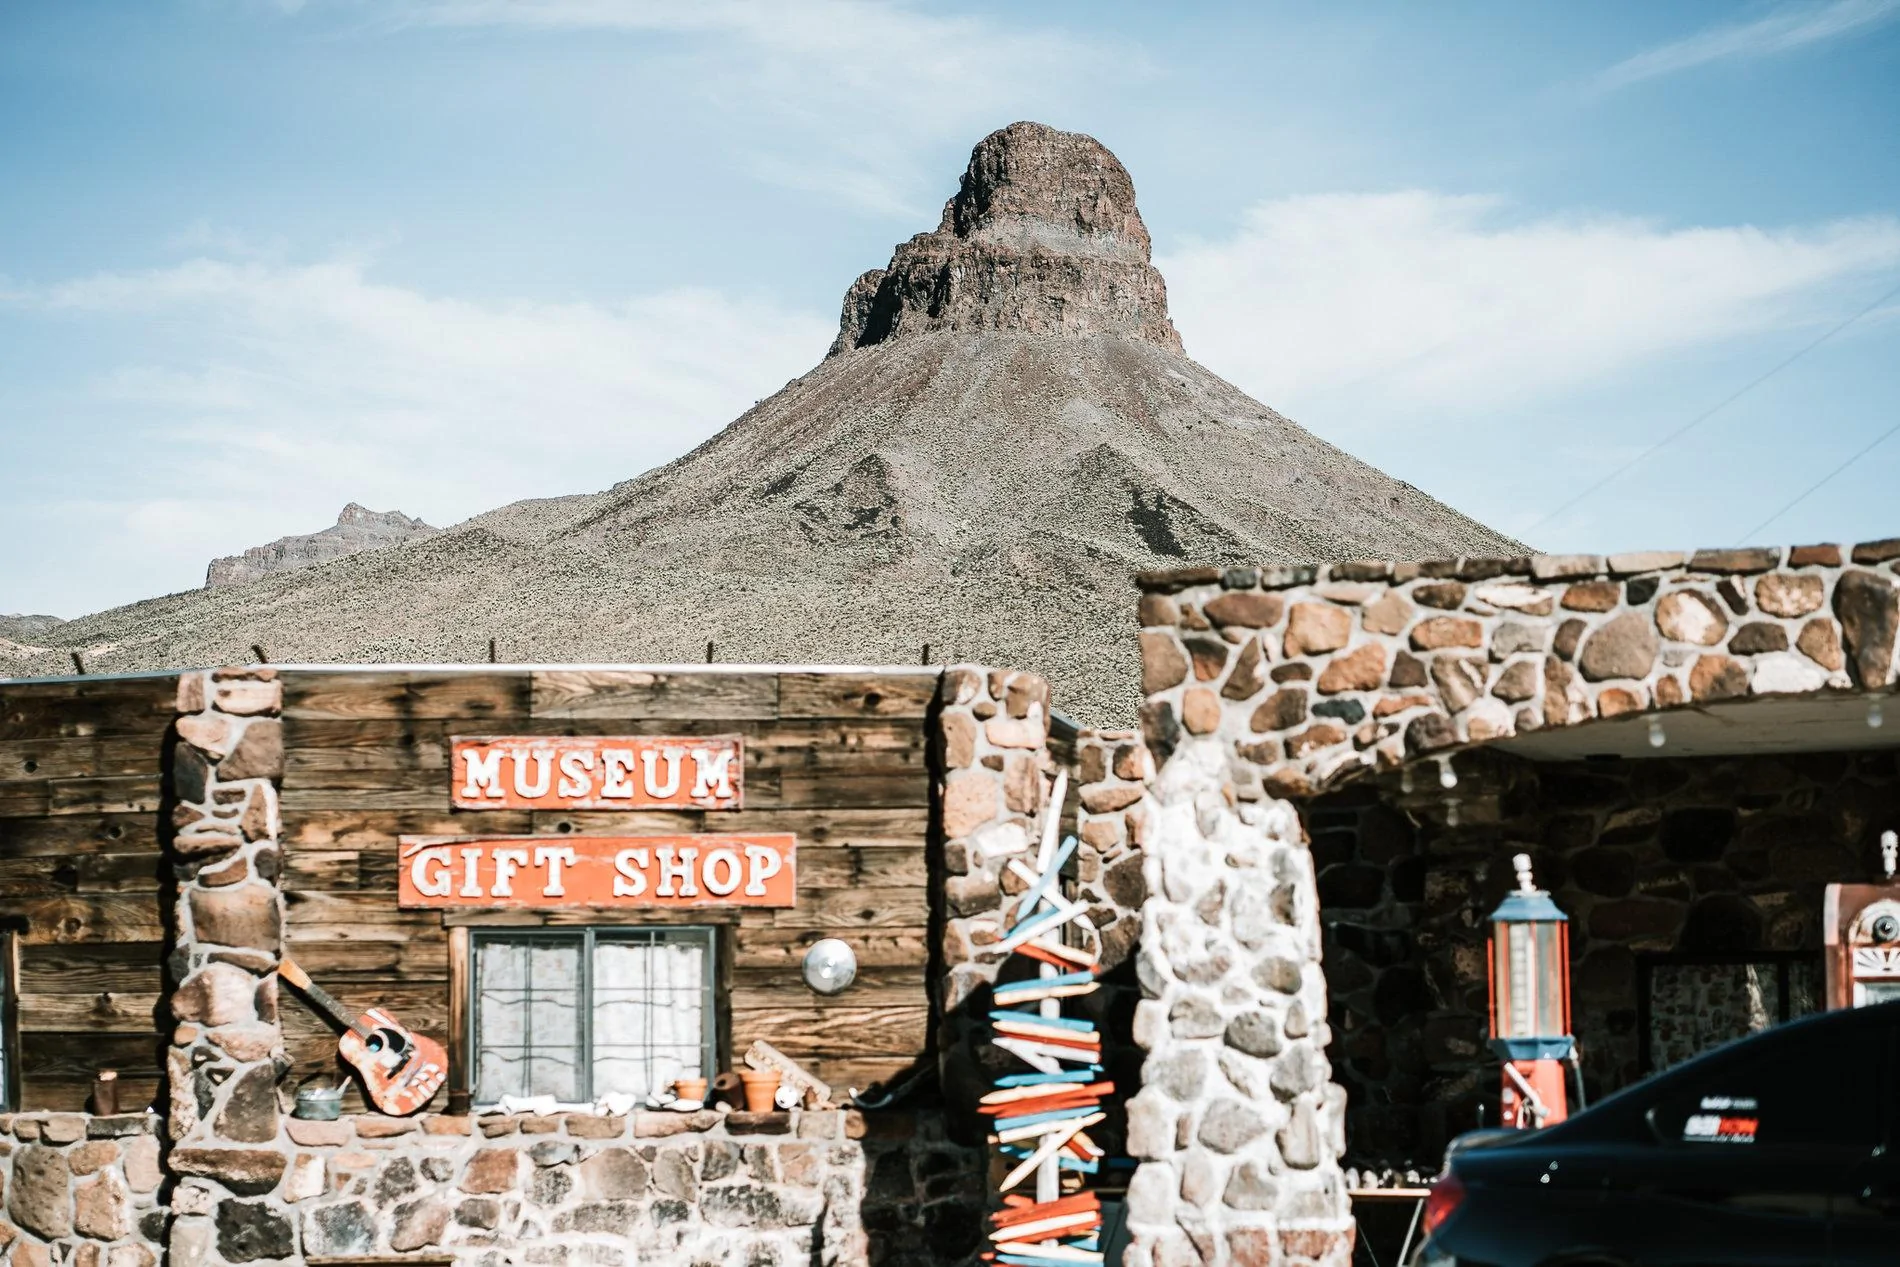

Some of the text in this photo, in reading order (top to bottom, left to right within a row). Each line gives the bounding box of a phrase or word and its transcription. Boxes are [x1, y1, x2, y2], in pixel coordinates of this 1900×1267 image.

[460, 748, 735, 799] MUSEUM
[411, 845, 783, 898] GIFT SHOP
